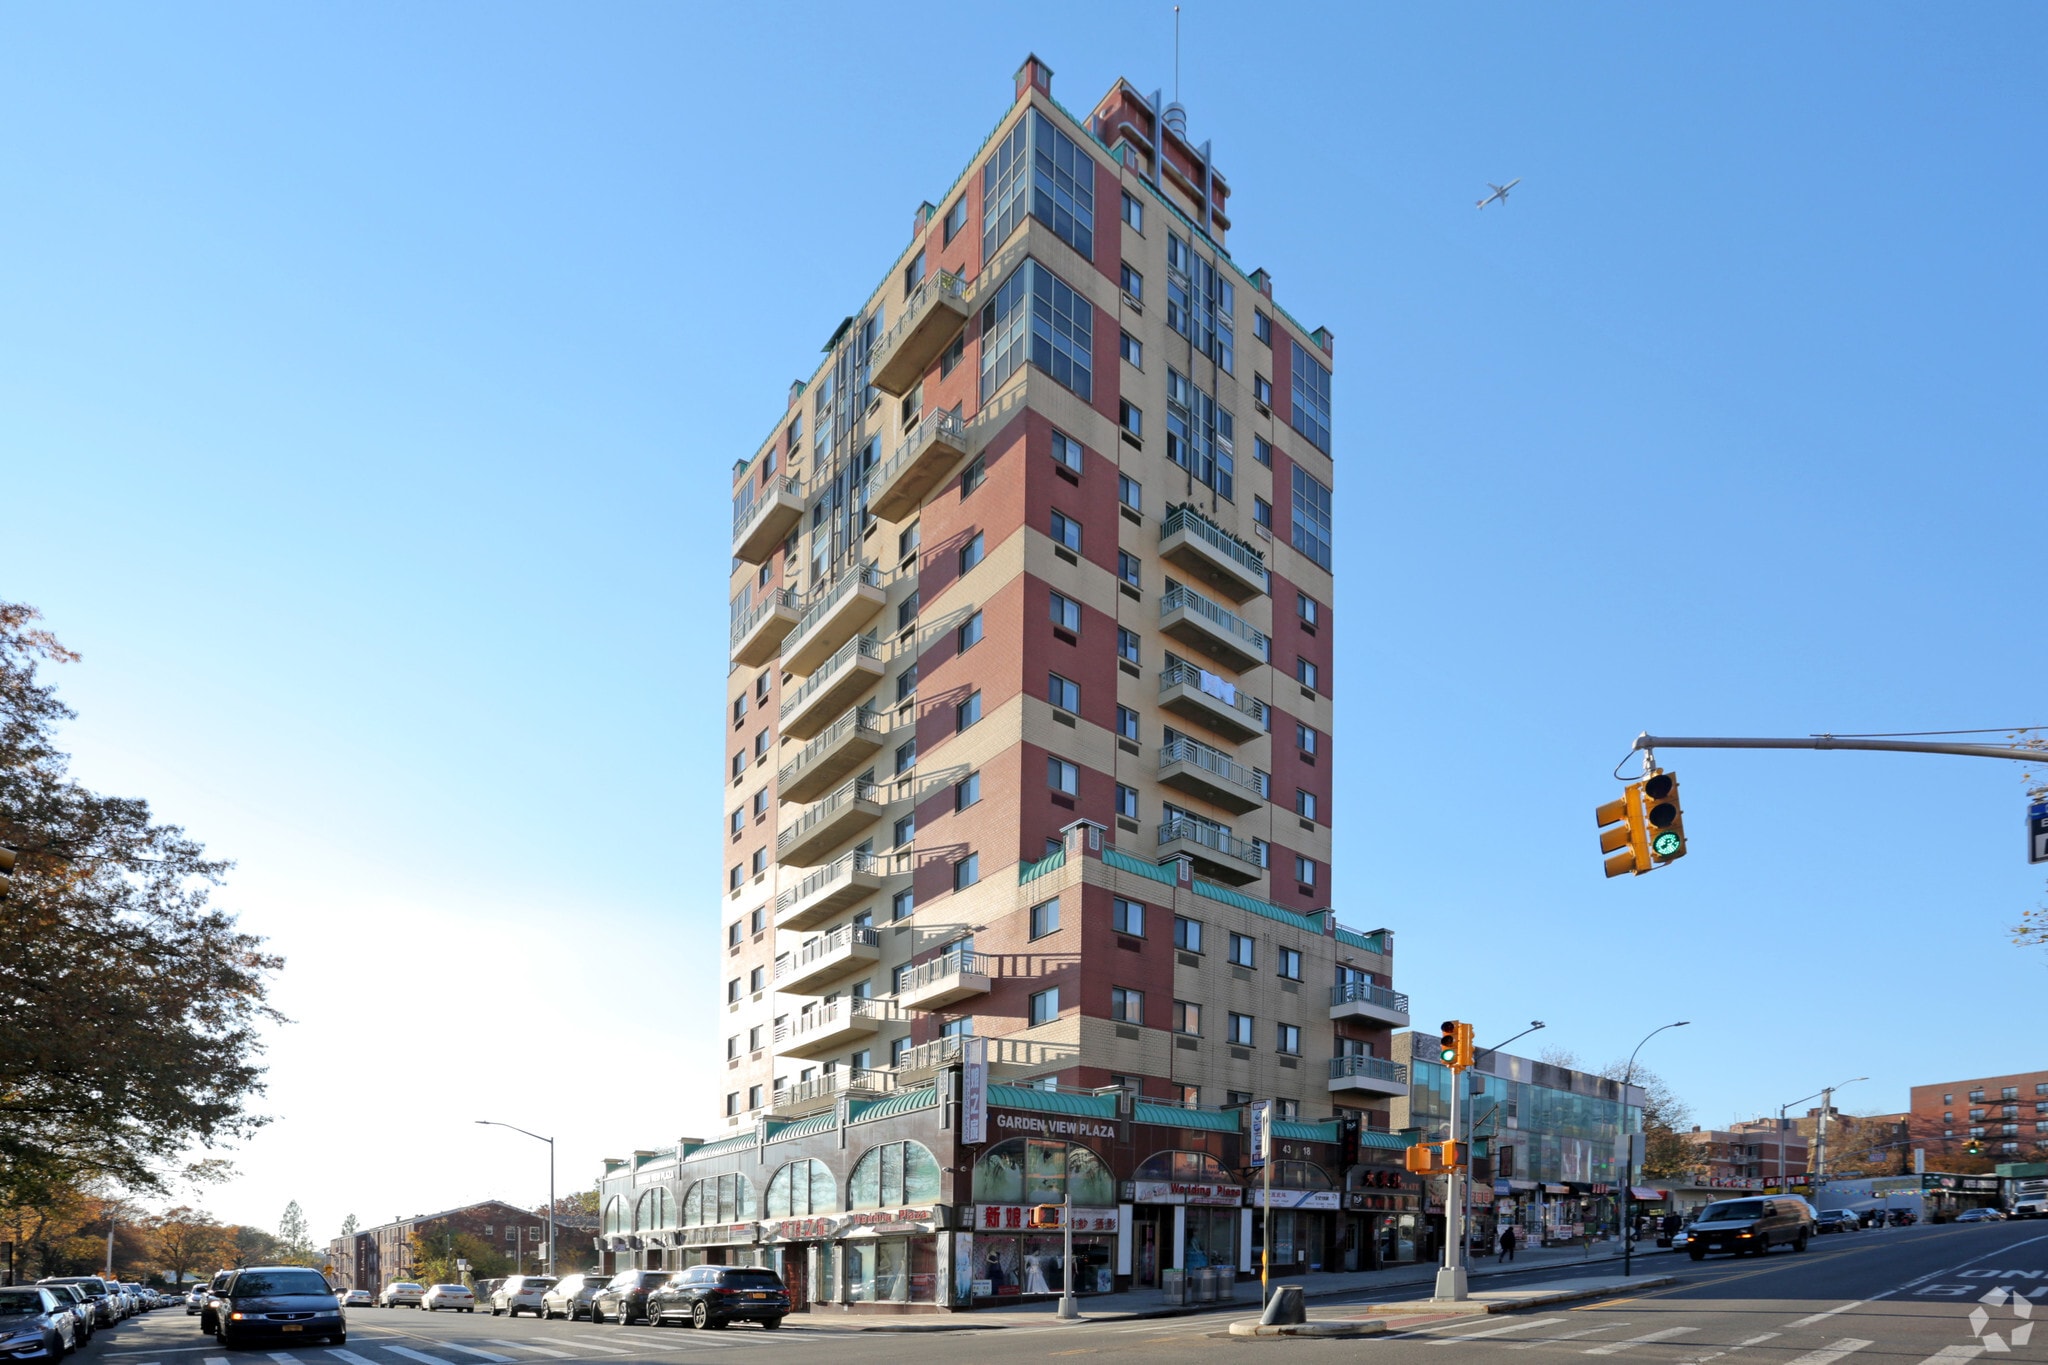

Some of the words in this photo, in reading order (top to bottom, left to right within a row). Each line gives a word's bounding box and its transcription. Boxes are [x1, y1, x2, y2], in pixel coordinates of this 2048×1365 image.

[997, 1114, 1045, 1132] GARDEN
[1049, 1120, 1077, 1135] VIEW
[1079, 1123, 1115, 1139] PLAZA
[1282, 1145, 1292, 1154] 43
[1303, 1147, 1311, 1156] 18
[853, 1213, 892, 1225] Wedding
[898, 1209, 928, 1221] Plaza
[1956, 1269, 2048, 1279] ON
